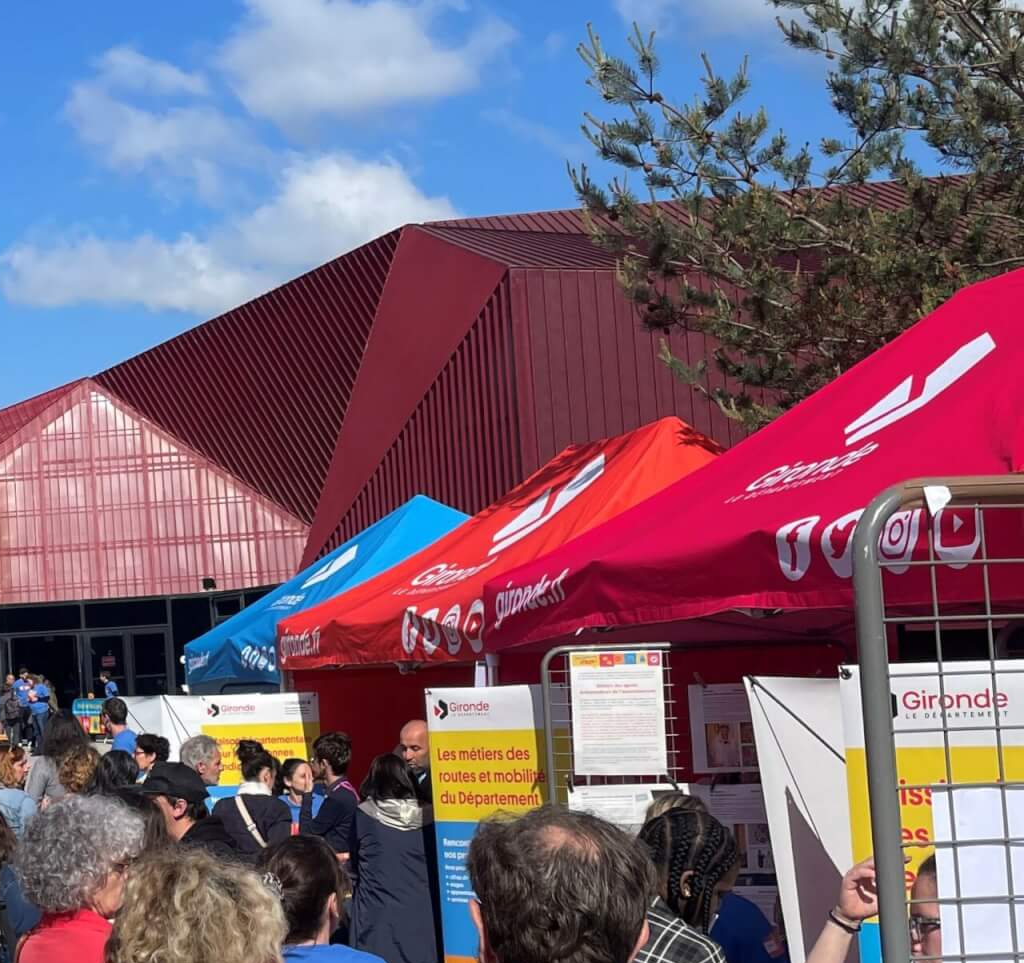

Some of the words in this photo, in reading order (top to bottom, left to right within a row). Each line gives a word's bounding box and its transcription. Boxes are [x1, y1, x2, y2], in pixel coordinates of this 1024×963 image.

[494, 568, 570, 629] gironde.fr
[449, 701, 490, 712] Gironde
[902, 688, 1009, 710] Gironde
[437, 748, 456, 761] Les
[459, 747, 503, 761] métiers
[506, 746, 530, 760] des
[439, 770, 476, 783] routes
[479, 771, 490, 782] et
[441, 791, 455, 804] du
[459, 791, 539, 807] Département
